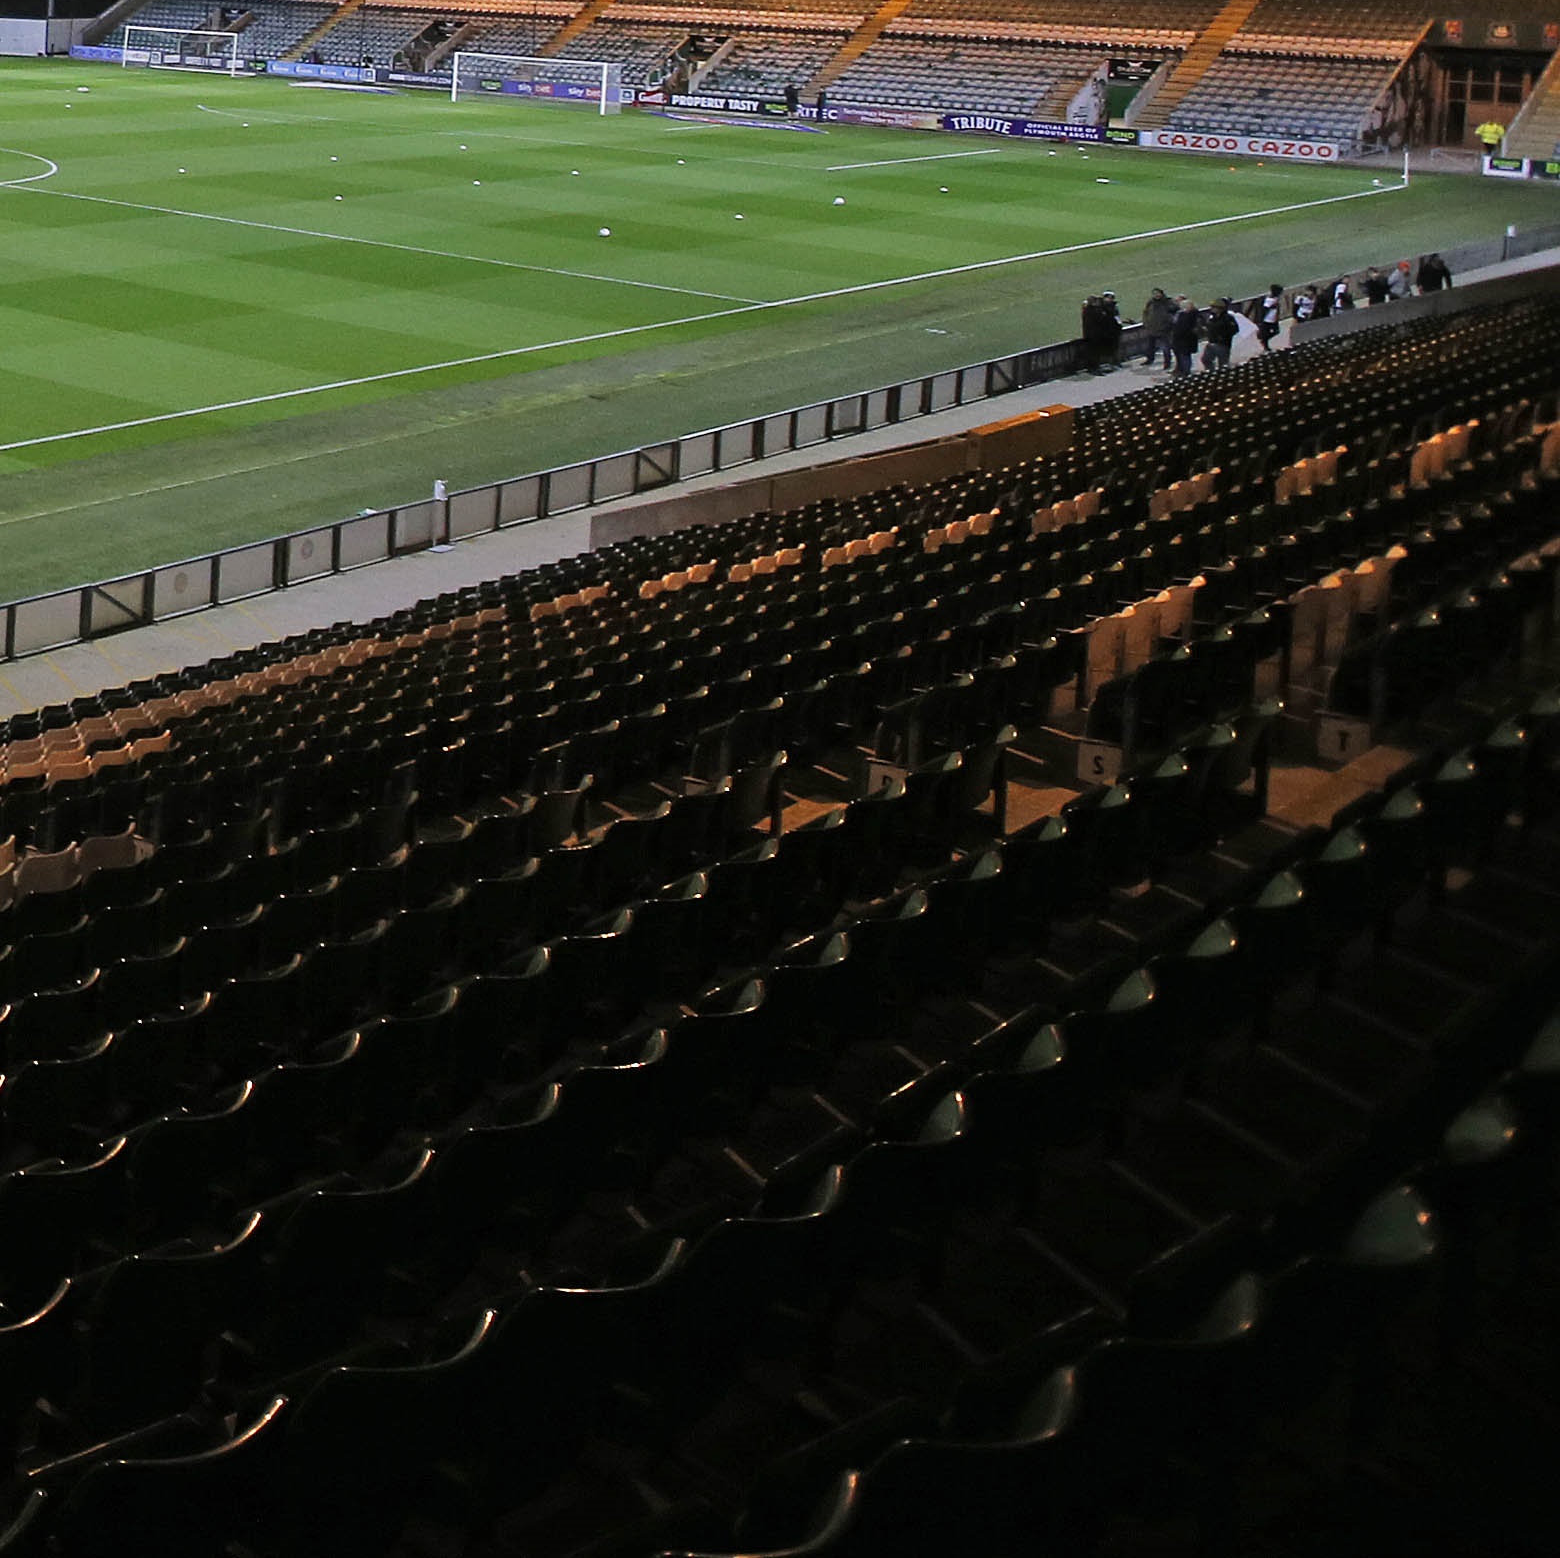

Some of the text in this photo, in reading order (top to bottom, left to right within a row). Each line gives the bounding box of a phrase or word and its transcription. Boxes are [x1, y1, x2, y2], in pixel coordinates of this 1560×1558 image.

[518, 83, 532, 93] sky
[568, 87, 584, 97] sky
[671, 95, 726, 109] PROPERLY
[728, 98, 759, 112] TASTY
[951, 117, 1013, 134] TRIBUTE
[1026, 122, 1062, 131] OFFICIAL
[1024, 128, 1099, 140] PLYMOUTH ARGYLE
[1157, 133, 1333, 158] CAZOO CAZOO
